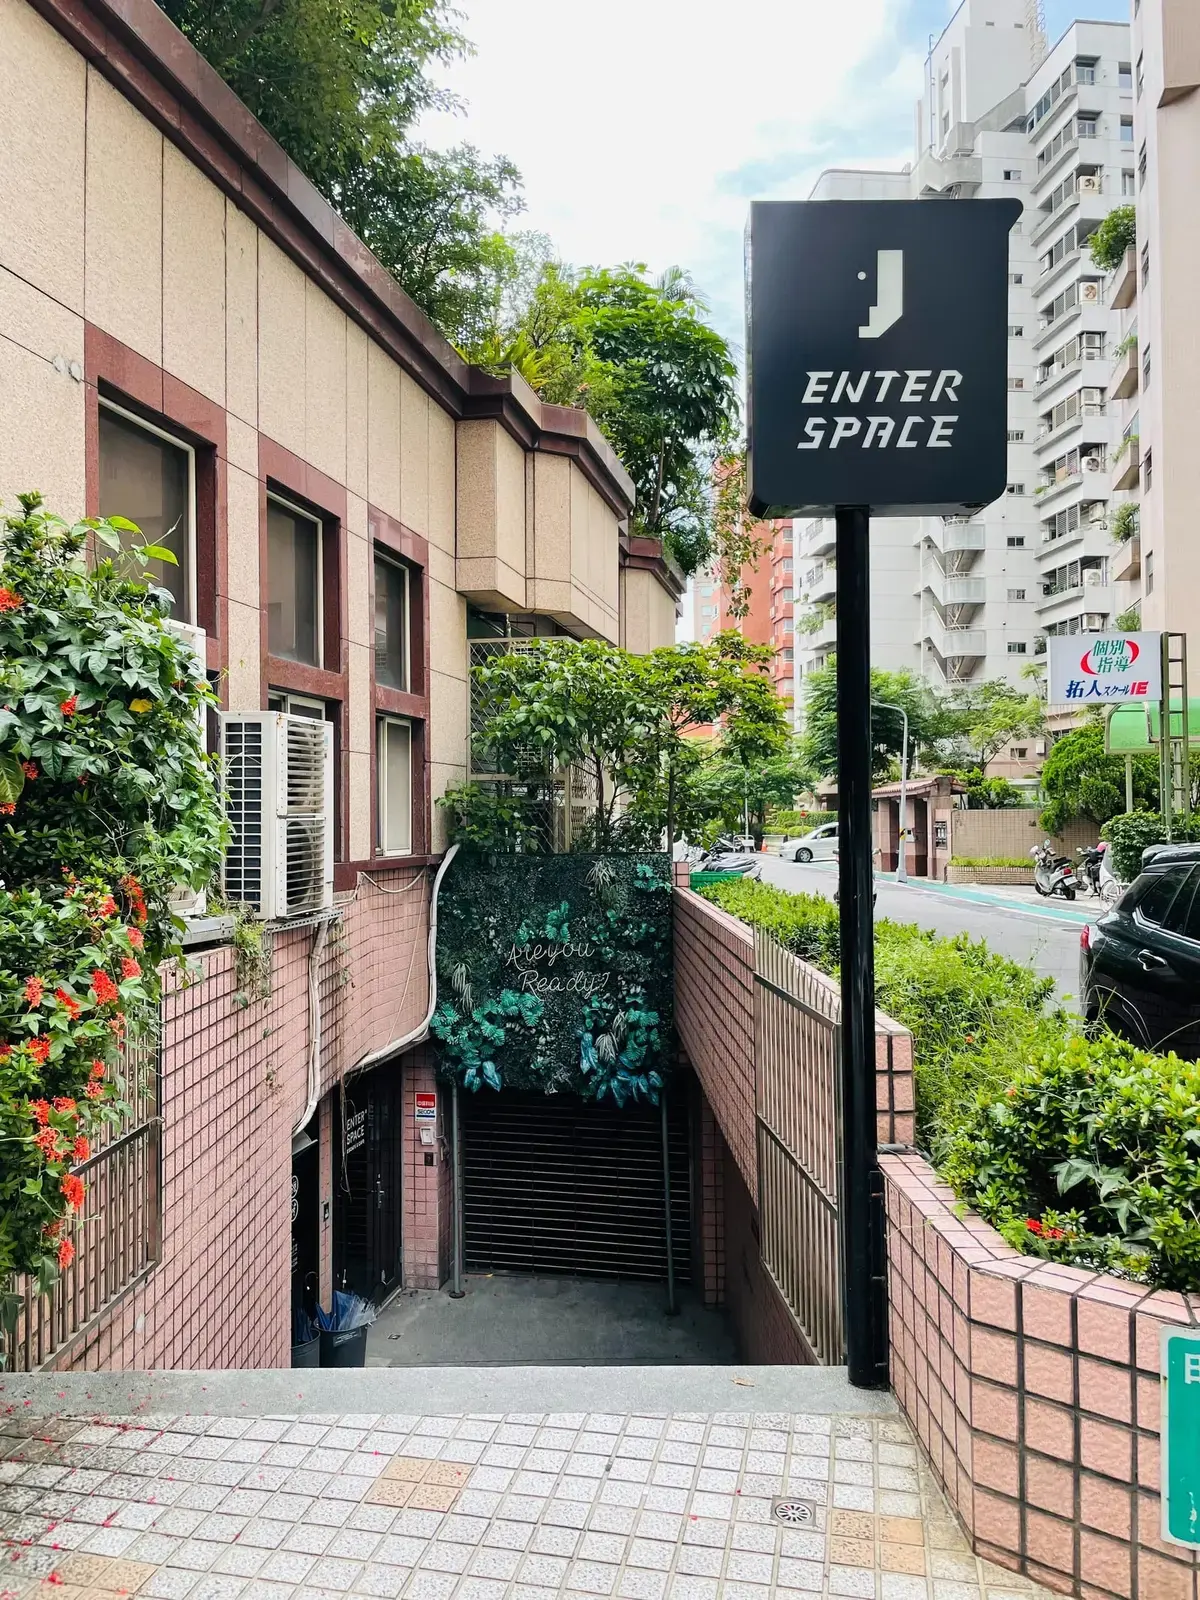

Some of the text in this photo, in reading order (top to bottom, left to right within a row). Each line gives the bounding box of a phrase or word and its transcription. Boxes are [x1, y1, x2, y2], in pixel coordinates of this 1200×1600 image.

[801, 370, 963, 403] ENTER
[797, 415, 959, 449] SPACE
[1092, 638, 1126, 657] 個別
[1097, 655, 1132, 673] 指導
[547, 942, 595, 966] you
[518, 969, 610, 1002] Ready?
[346, 1110, 365, 1131] ENTER
[346, 1124, 365, 1145] SPACE
